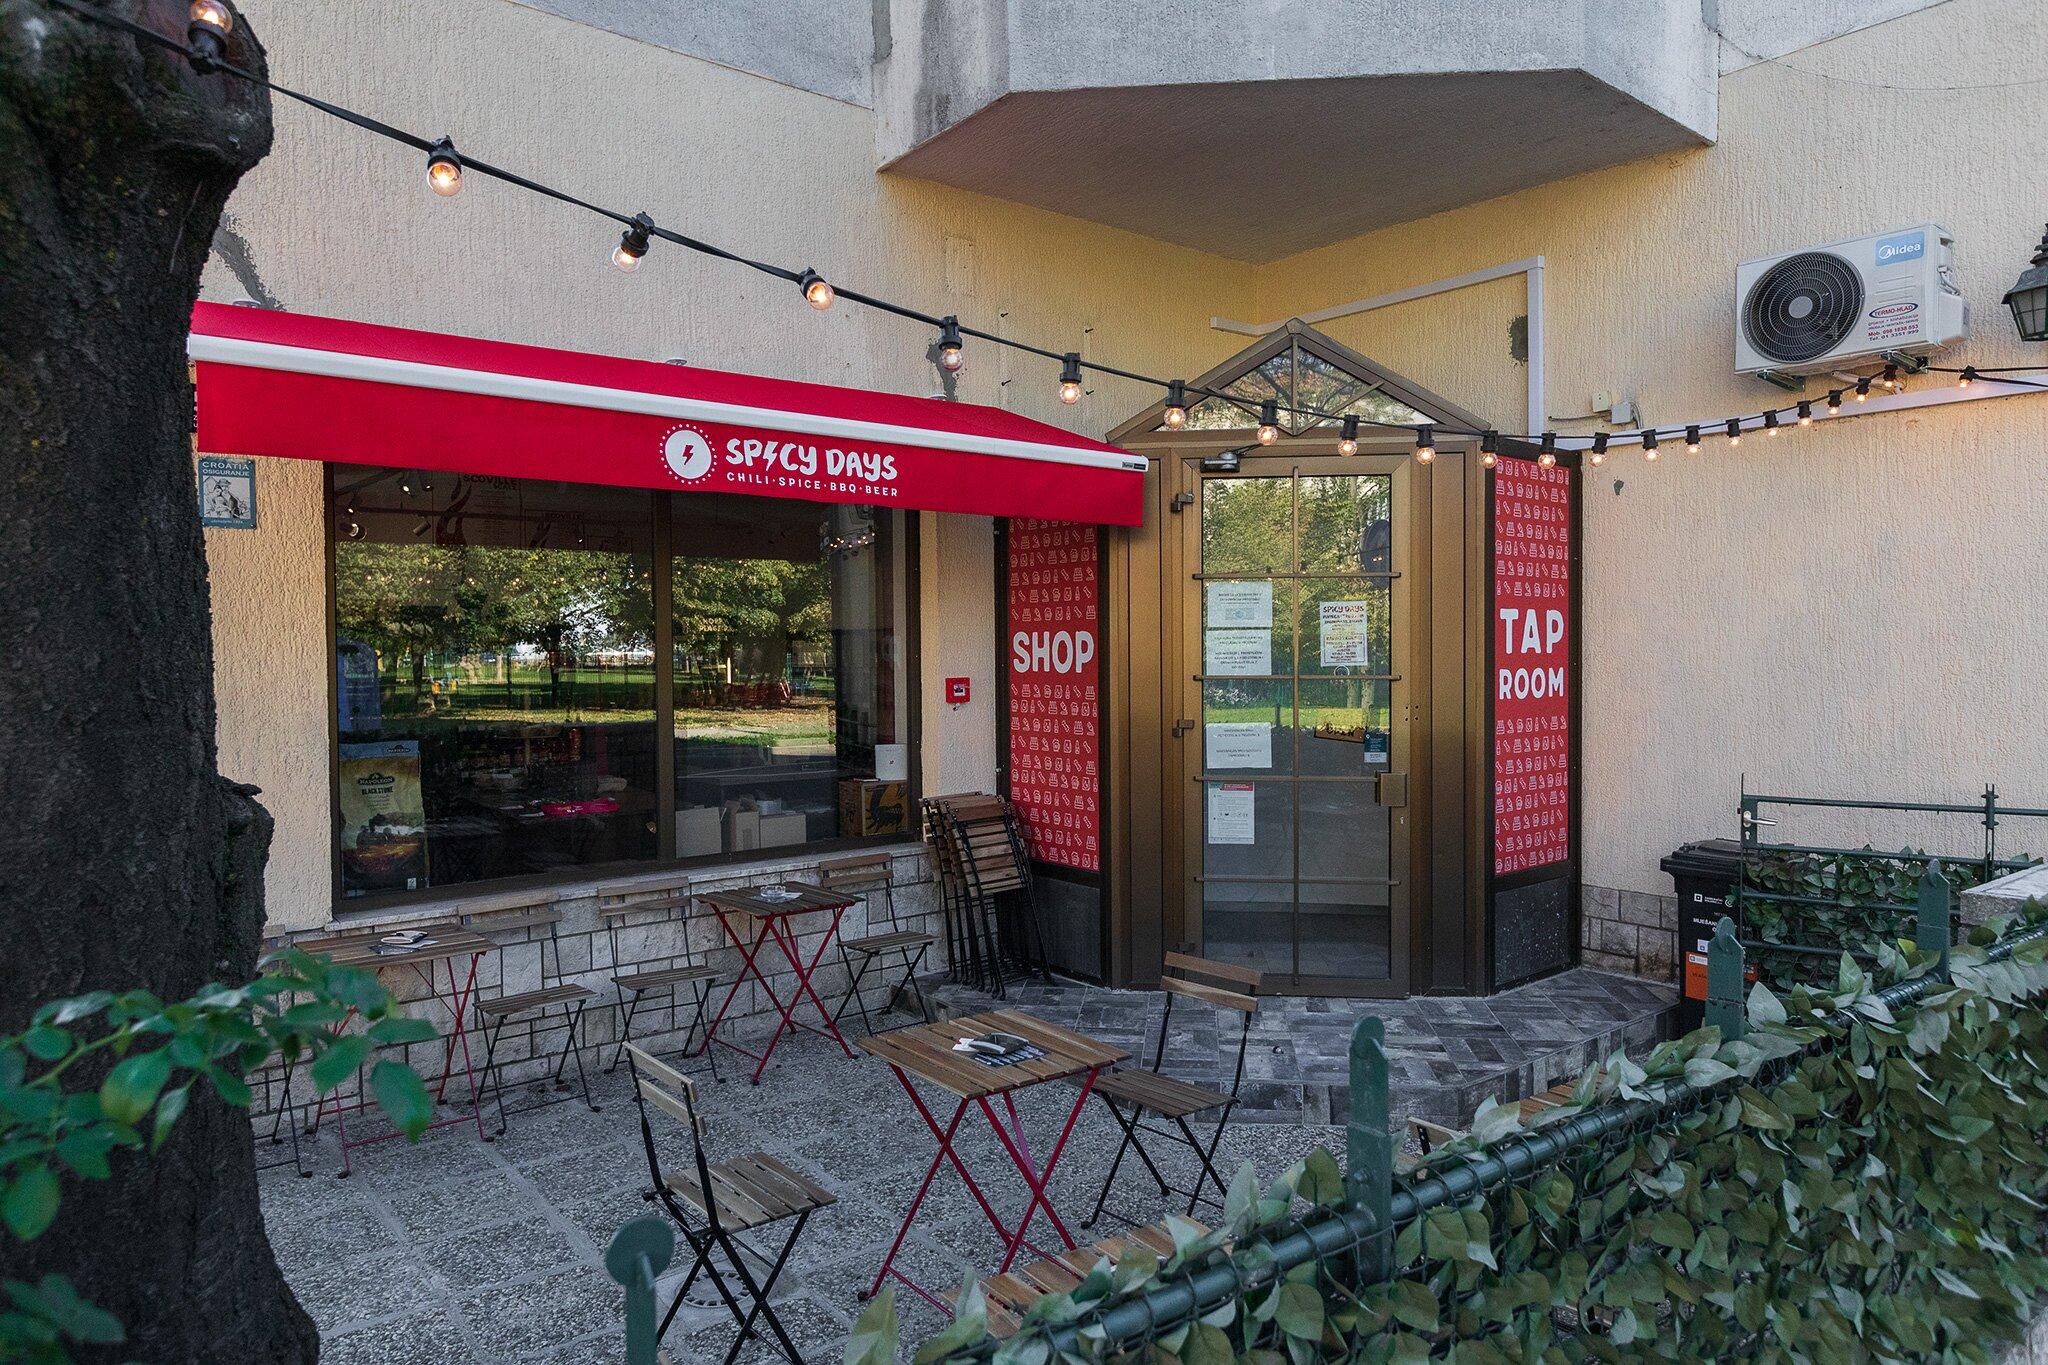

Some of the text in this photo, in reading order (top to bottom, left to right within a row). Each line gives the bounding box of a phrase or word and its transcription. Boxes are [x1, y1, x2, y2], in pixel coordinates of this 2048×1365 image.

[1879, 243, 1921, 259] Midea
[202, 461, 250, 470] CROATIA
[725, 438, 898, 482] SPICY DAYS
[202, 469, 250, 477] OSIGURANJE
[727, 472, 898, 497] CHILI SPICE BBQ BEER
[1500, 608, 1565, 654] TAP
[1012, 630, 1095, 674] SHOP
[1498, 667, 1565, 700] ROOM
[359, 777, 393, 785] NAPOLEON
